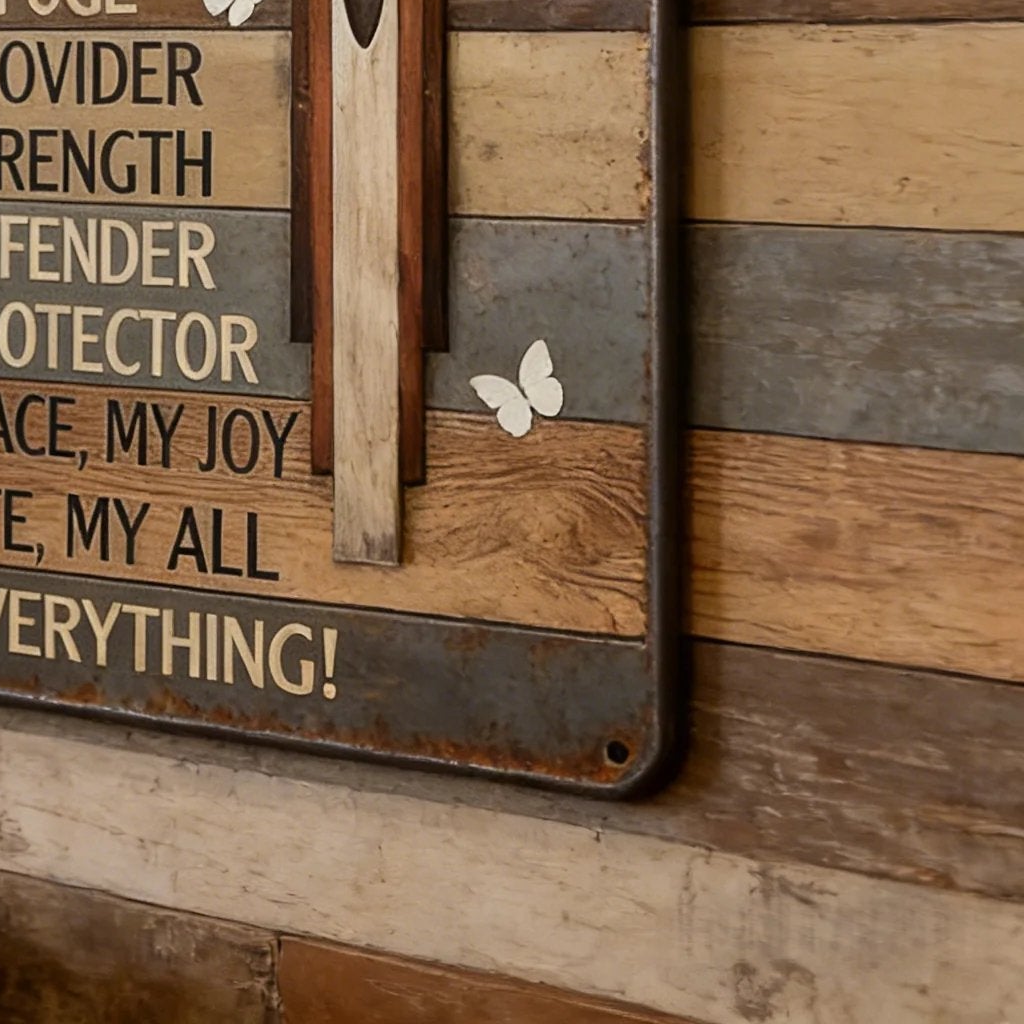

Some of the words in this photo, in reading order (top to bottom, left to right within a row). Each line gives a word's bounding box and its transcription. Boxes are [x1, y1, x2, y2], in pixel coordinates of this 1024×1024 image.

[106, 399, 184, 468] MY
[198, 406, 303, 478] JOY
[67, 493, 150, 565] MY
[167, 507, 279, 581] ALL
